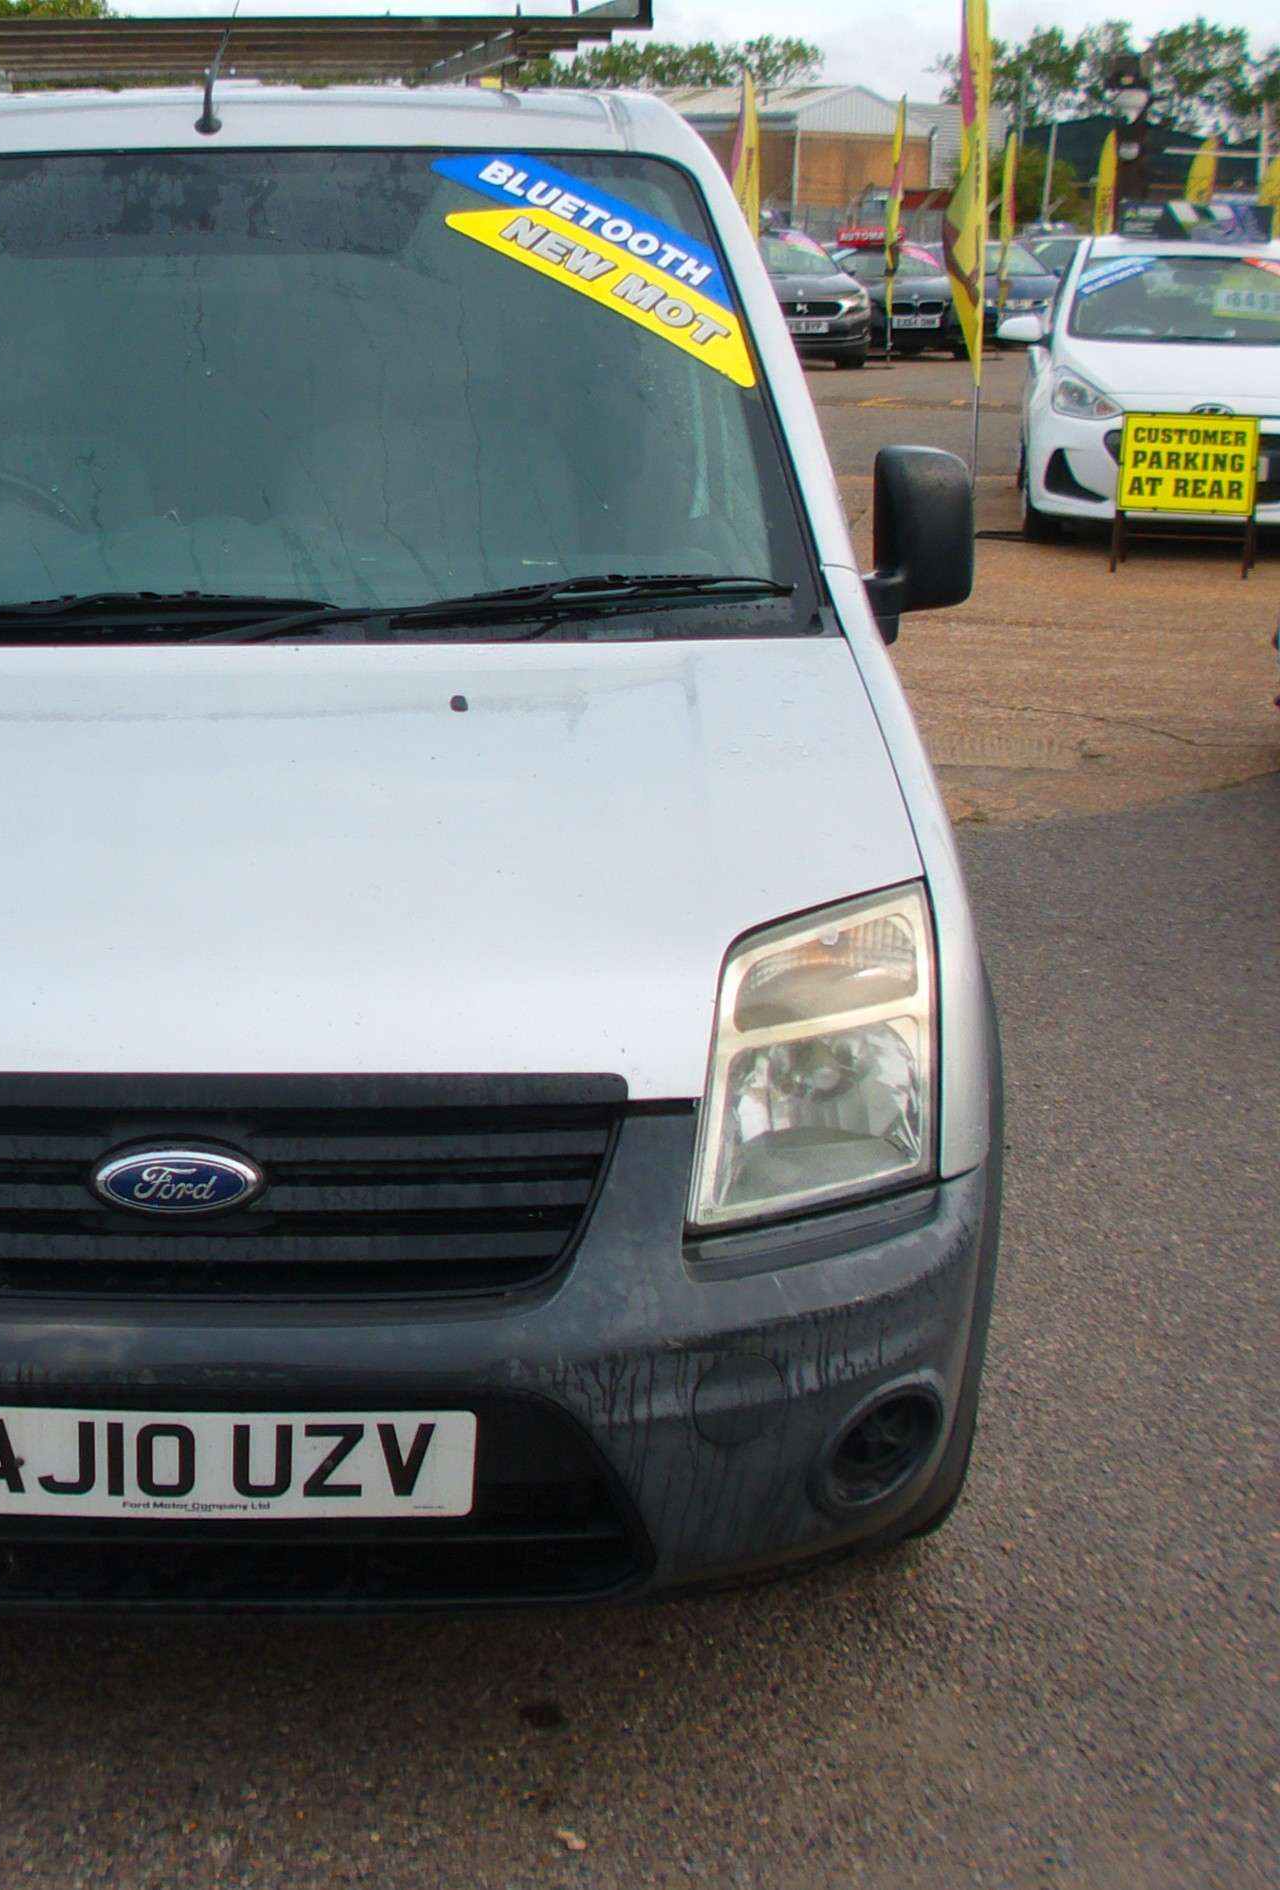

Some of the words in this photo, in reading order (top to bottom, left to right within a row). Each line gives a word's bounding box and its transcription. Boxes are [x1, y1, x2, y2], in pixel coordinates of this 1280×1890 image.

[477, 159, 713, 288] BLUETOOTH
[839, 229, 903, 241] AUTOMAC
[500, 215, 617, 282] NEW
[611, 272, 731, 345] MOT
[1133, 427, 1248, 447] CUSTOMER
[1131, 450, 1246, 473] PARKING
[1127, 476, 1163, 497] AT
[1172, 478, 1244, 501] REAR
[133, 1165, 219, 1200] Ford
[232, 1423, 437, 1499] UZV
[122, 1501, 151, 1510] Ford
[152, 1501, 188, 1511] Motor
[250, 1502, 271, 1511] Ltd
